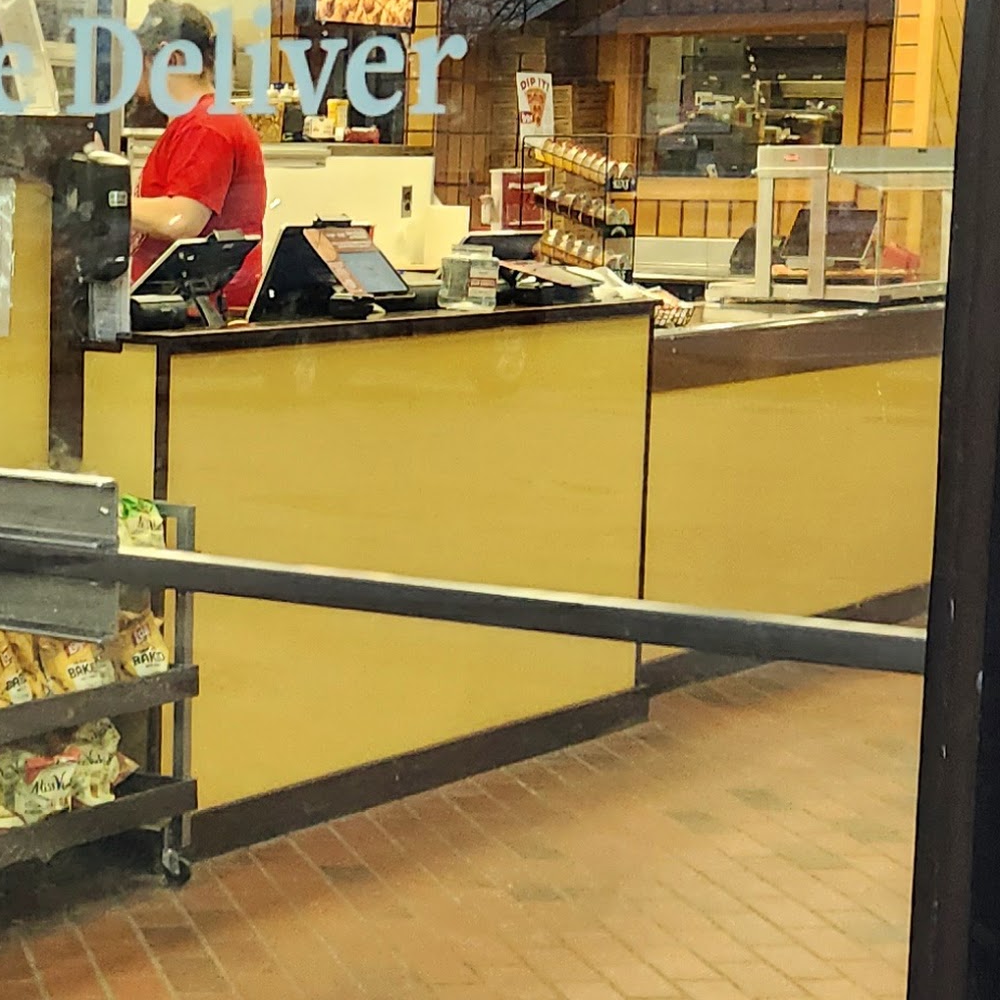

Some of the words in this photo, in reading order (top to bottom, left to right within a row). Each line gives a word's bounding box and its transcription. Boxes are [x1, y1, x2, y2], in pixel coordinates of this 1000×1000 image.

[65, 3, 468, 116] Deliver
[520, 77, 536, 91] DIP
[538, 78, 550, 92] IT!
